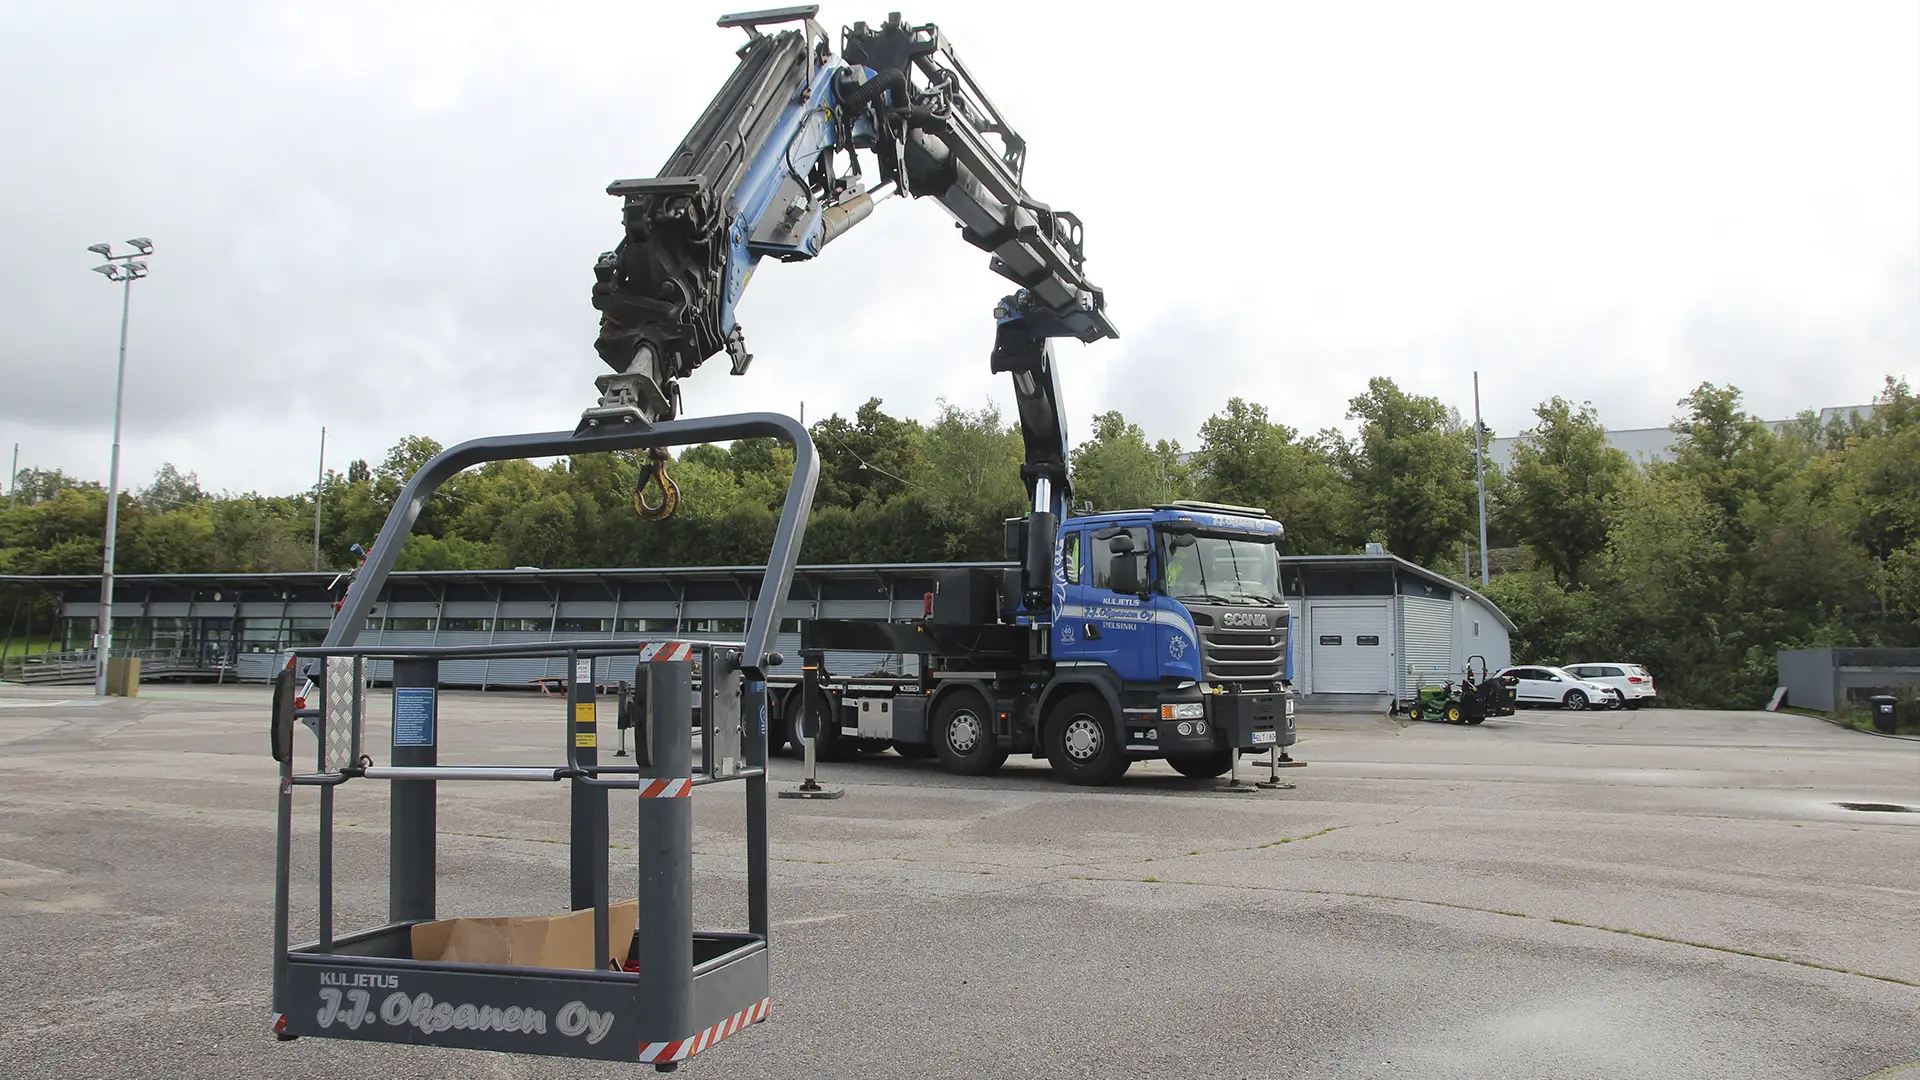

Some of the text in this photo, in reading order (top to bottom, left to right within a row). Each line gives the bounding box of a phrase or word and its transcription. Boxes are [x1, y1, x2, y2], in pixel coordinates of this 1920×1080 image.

[1102, 597, 1140, 607] KULJETUS
[1139, 610, 1154, 621] Oy
[1223, 612, 1269, 627] SCANIA
[1102, 621, 1137, 631] HELSINKI
[320, 972, 399, 988] KULJETUS
[316, 988, 615, 1045] J.J. Oksanen Oy
